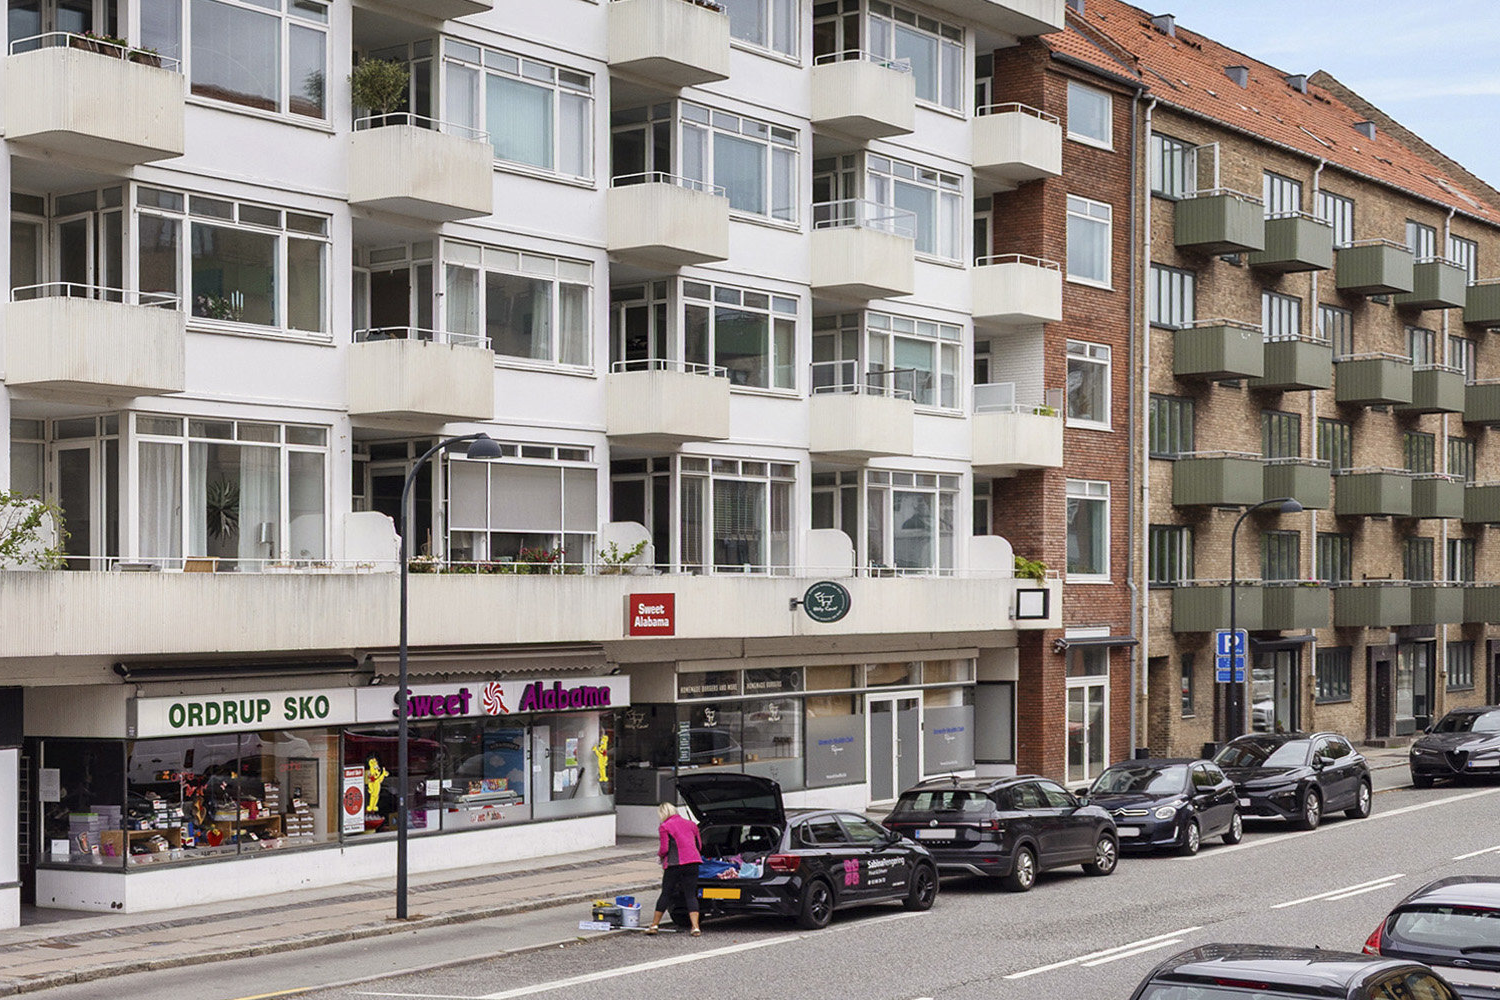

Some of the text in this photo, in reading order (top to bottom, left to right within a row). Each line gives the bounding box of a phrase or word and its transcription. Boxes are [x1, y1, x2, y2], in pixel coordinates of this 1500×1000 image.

[638, 603, 665, 615] Sweet
[634, 616, 669, 627] Alabama
[1224, 634, 1240, 653] P
[680, 686, 700, 694] HOMEMADE
[393, 681, 611, 717] Sweet Alabama
[169, 695, 330, 728] ORDRUP SKO
